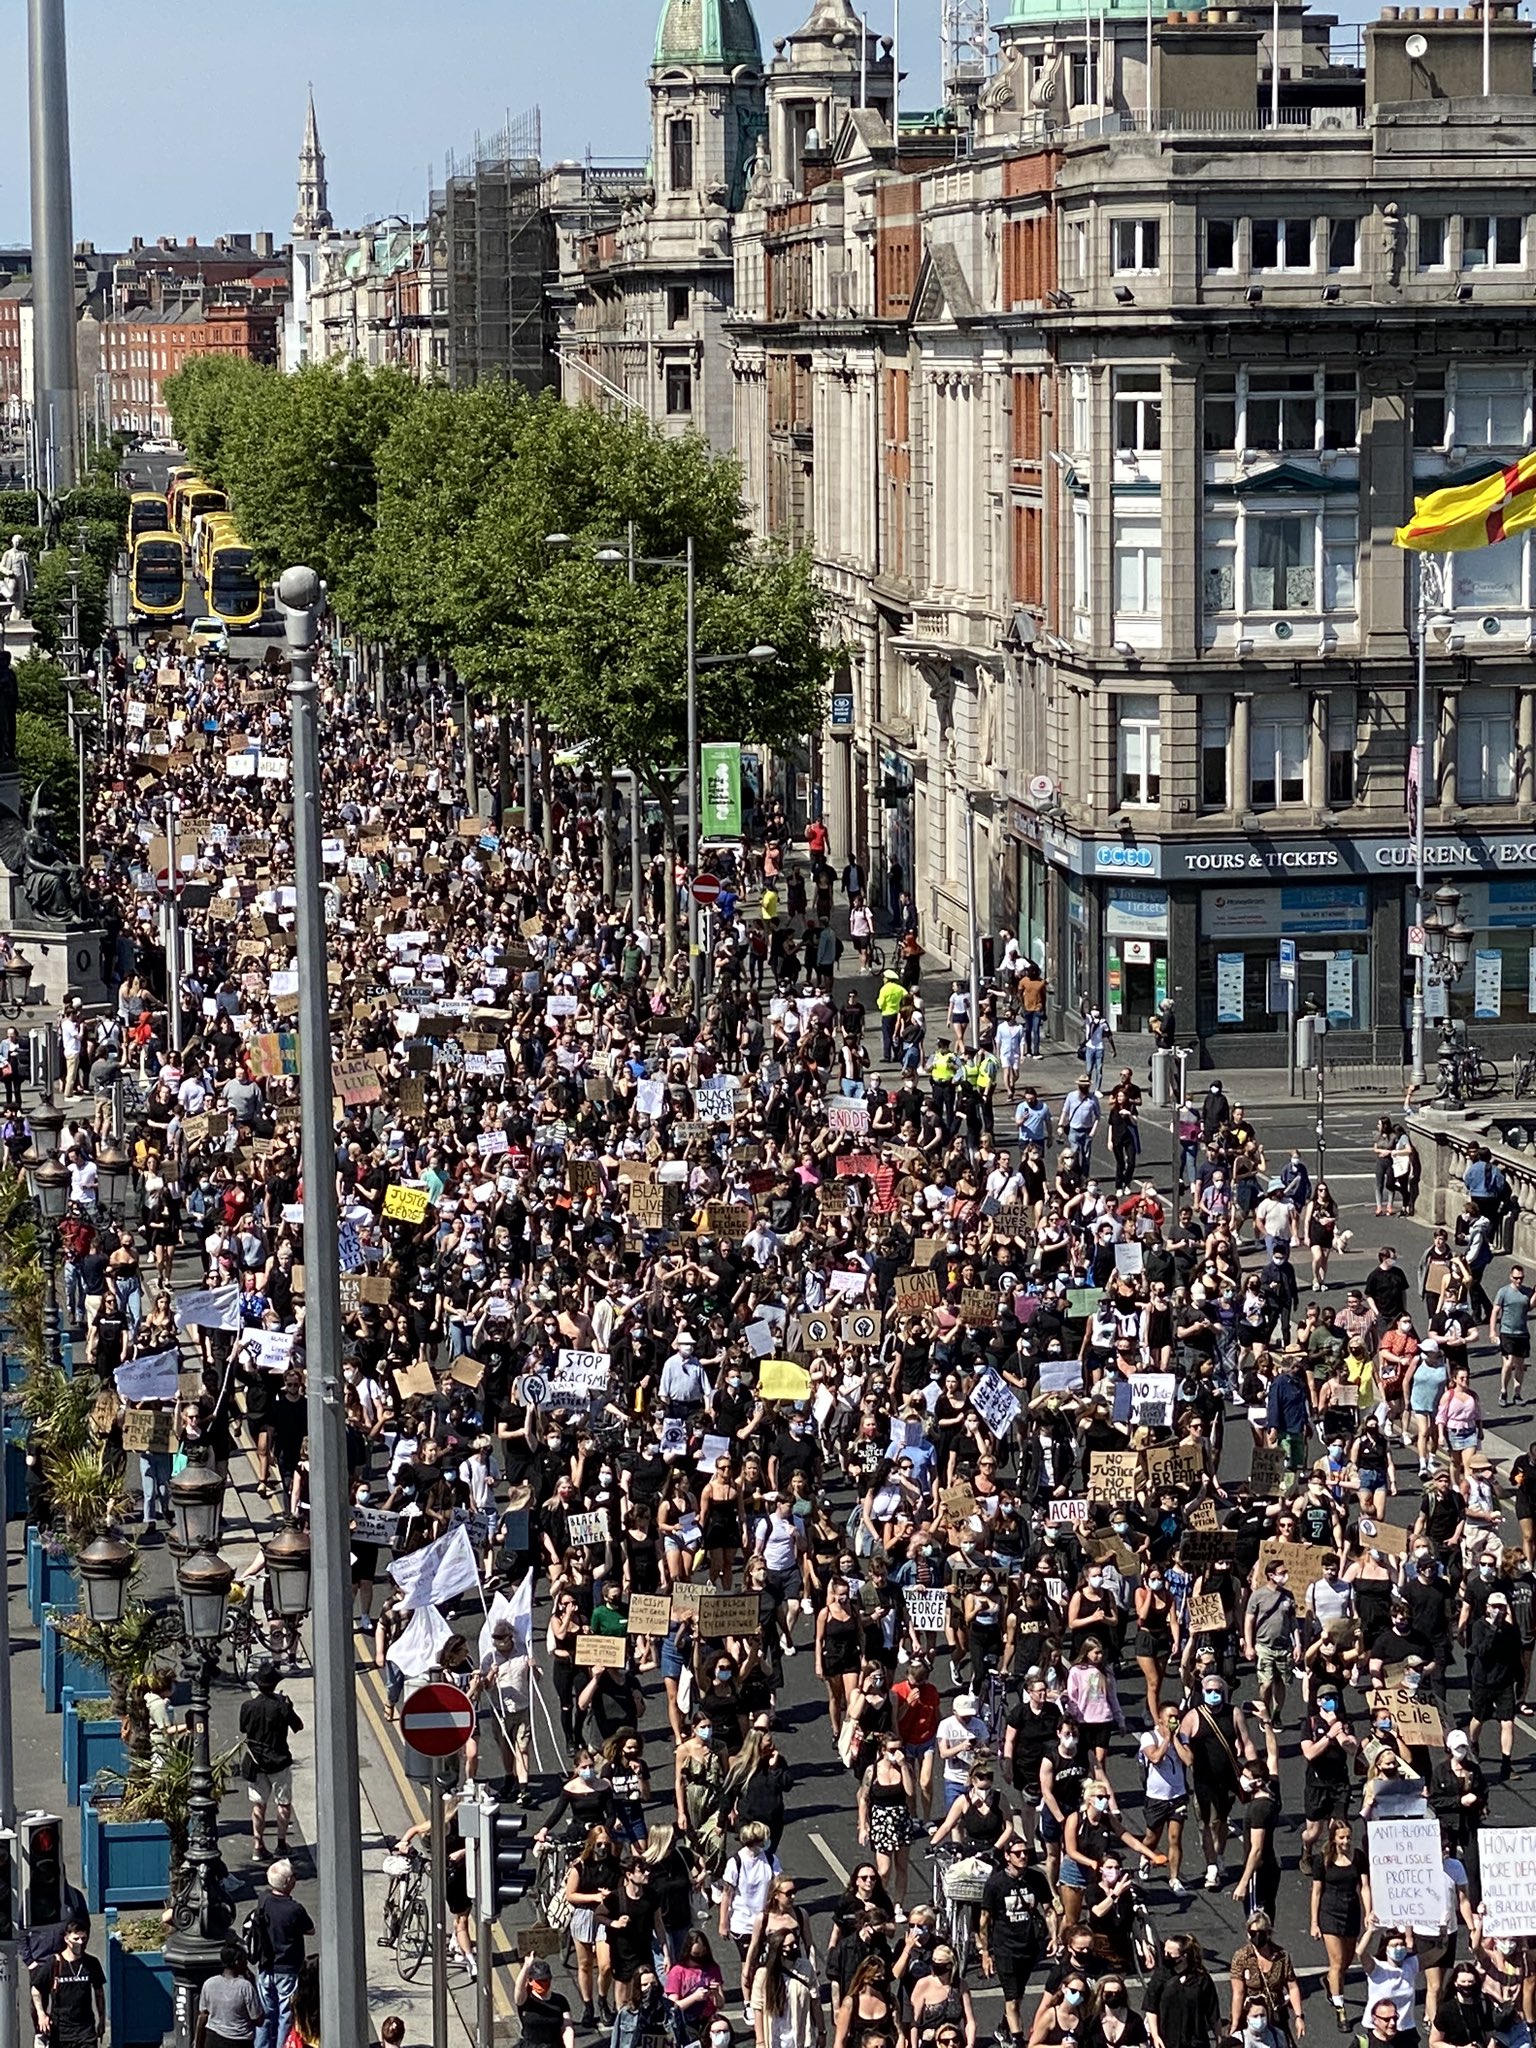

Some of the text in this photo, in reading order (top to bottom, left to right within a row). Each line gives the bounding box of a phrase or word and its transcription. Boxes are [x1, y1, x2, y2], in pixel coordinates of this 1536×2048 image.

[1185, 851, 1339, 869] TOURS & TICKETS
[1127, 901, 1166, 913] Tickets
[333, 1059, 373, 1076] BLACK
[344, 1074, 377, 1090] LIVES
[699, 1090, 731, 1101] BLACK
[706, 1100, 732, 1108] LIVES
[698, 1106, 733, 1116] MATTER
[632, 1183, 678, 1199] BLACK
[638, 1199, 671, 1212] LIVES
[712, 1220, 748, 1229] GEORGE
[339, 1238, 361, 1254] VES
[340, 1280, 360, 1293] ACK
[900, 1278, 906, 1293] I
[566, 1352, 602, 1370] STOP
[560, 1370, 606, 1388] RACISM!
[1133, 1382, 1149, 1398] NO
[858, 1449, 884, 1457] JUSTICE
[1168, 1446, 1180, 1459] I
[866, 1456, 878, 1464] NO
[1105, 1454, 1122, 1465] NO
[1153, 1456, 1194, 1471] CANT
[1092, 1464, 1133, 1478] JUSTICE
[1105, 1477, 1124, 1488] NO
[1093, 1487, 1132, 1500] PEACE
[1052, 1501, 1087, 1520] ACAB
[1194, 1510, 1210, 1519] NOT
[570, 1513, 600, 1527] BLACK
[1312, 1522, 1323, 1538] 7
[572, 1533, 606, 1546] MATTER
[632, 1596, 664, 1607] RACISM
[1188, 1594, 1219, 1608] BLACK
[1190, 1604, 1219, 1617] LIVES
[913, 1615, 944, 1628] LOYD
[1192, 1613, 1225, 1627] MATTER
[1374, 1690, 1392, 1706] Ar
[1396, 1841, 1413, 1851] IS A
[1484, 1836, 1516, 1854] HOW
[1373, 1855, 1433, 1866] GLOBAL ISSUE
[1386, 1868, 1434, 1885] PROTECT
[1482, 1862, 1511, 1878] MORE
[1388, 1887, 1422, 1900] BLACK
[1484, 1884, 1506, 1898] WILL
[1509, 1883, 1520, 1896] IT
[1390, 1903, 1425, 1916] LIVES
